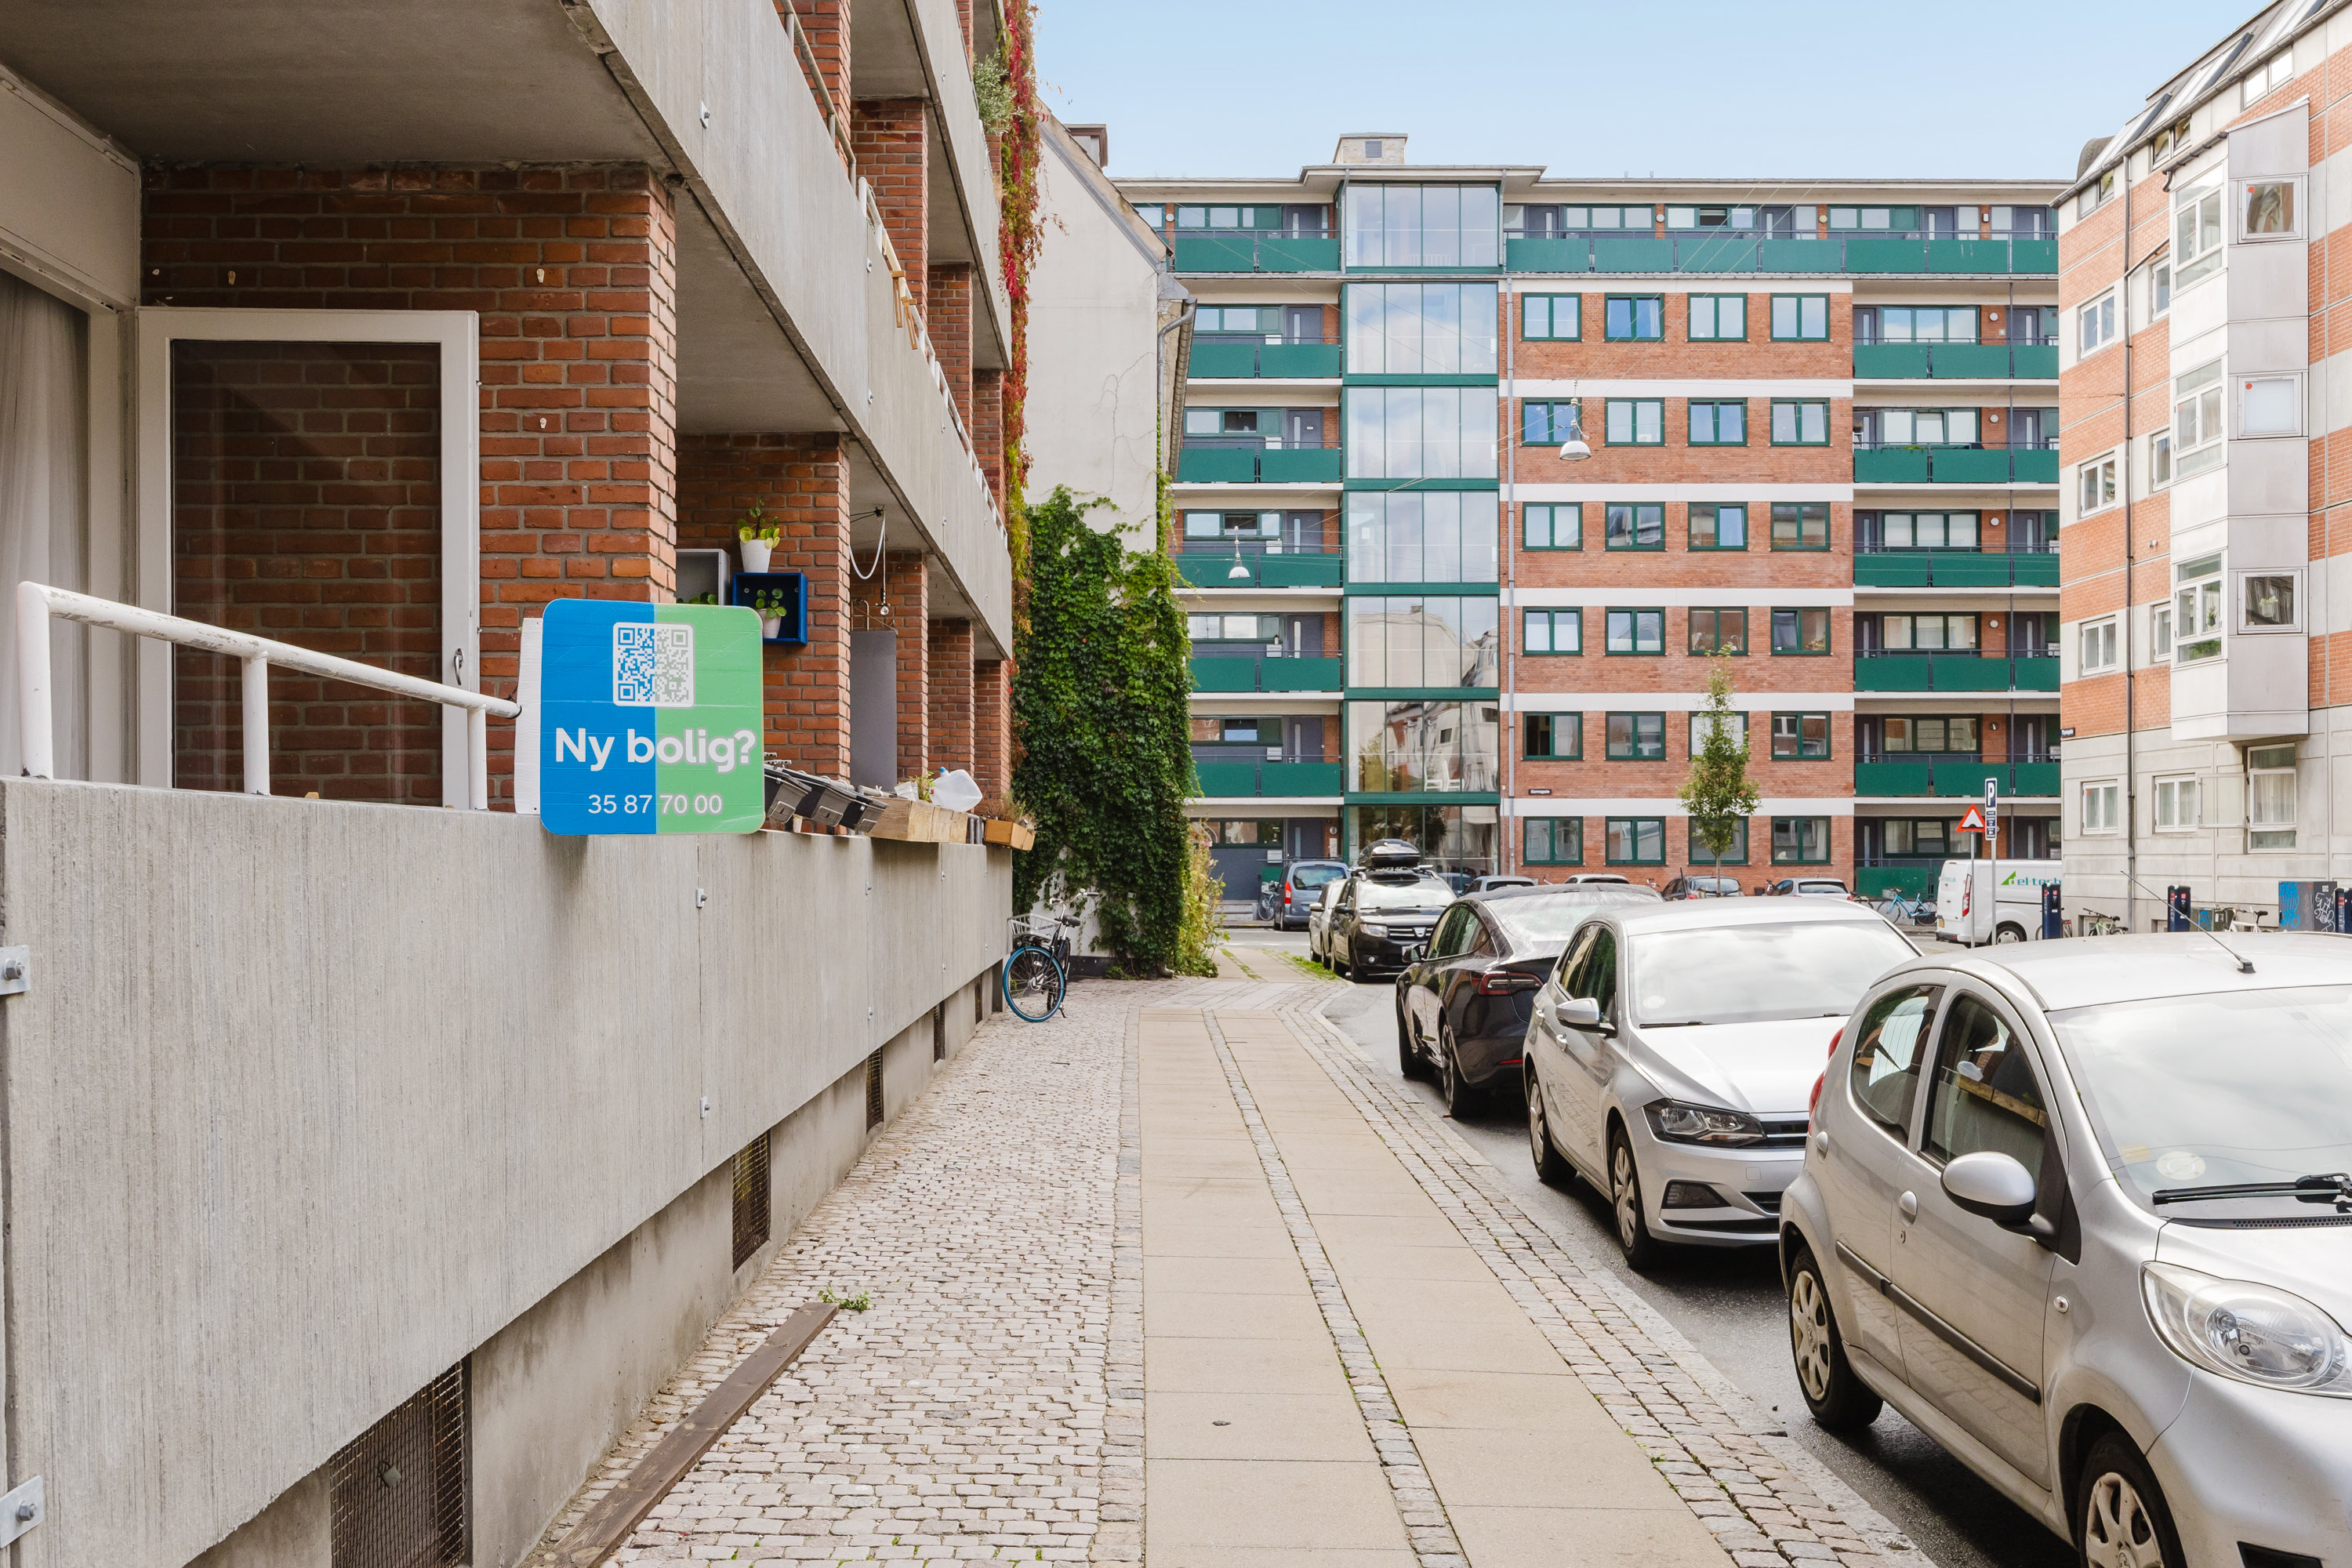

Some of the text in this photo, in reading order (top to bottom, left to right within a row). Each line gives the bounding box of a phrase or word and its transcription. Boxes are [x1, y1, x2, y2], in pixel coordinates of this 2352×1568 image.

[555, 728, 757, 773] Ny bolig?
[588, 793, 723, 815] 35 87 70 00
[1987, 782, 1994, 806] P
